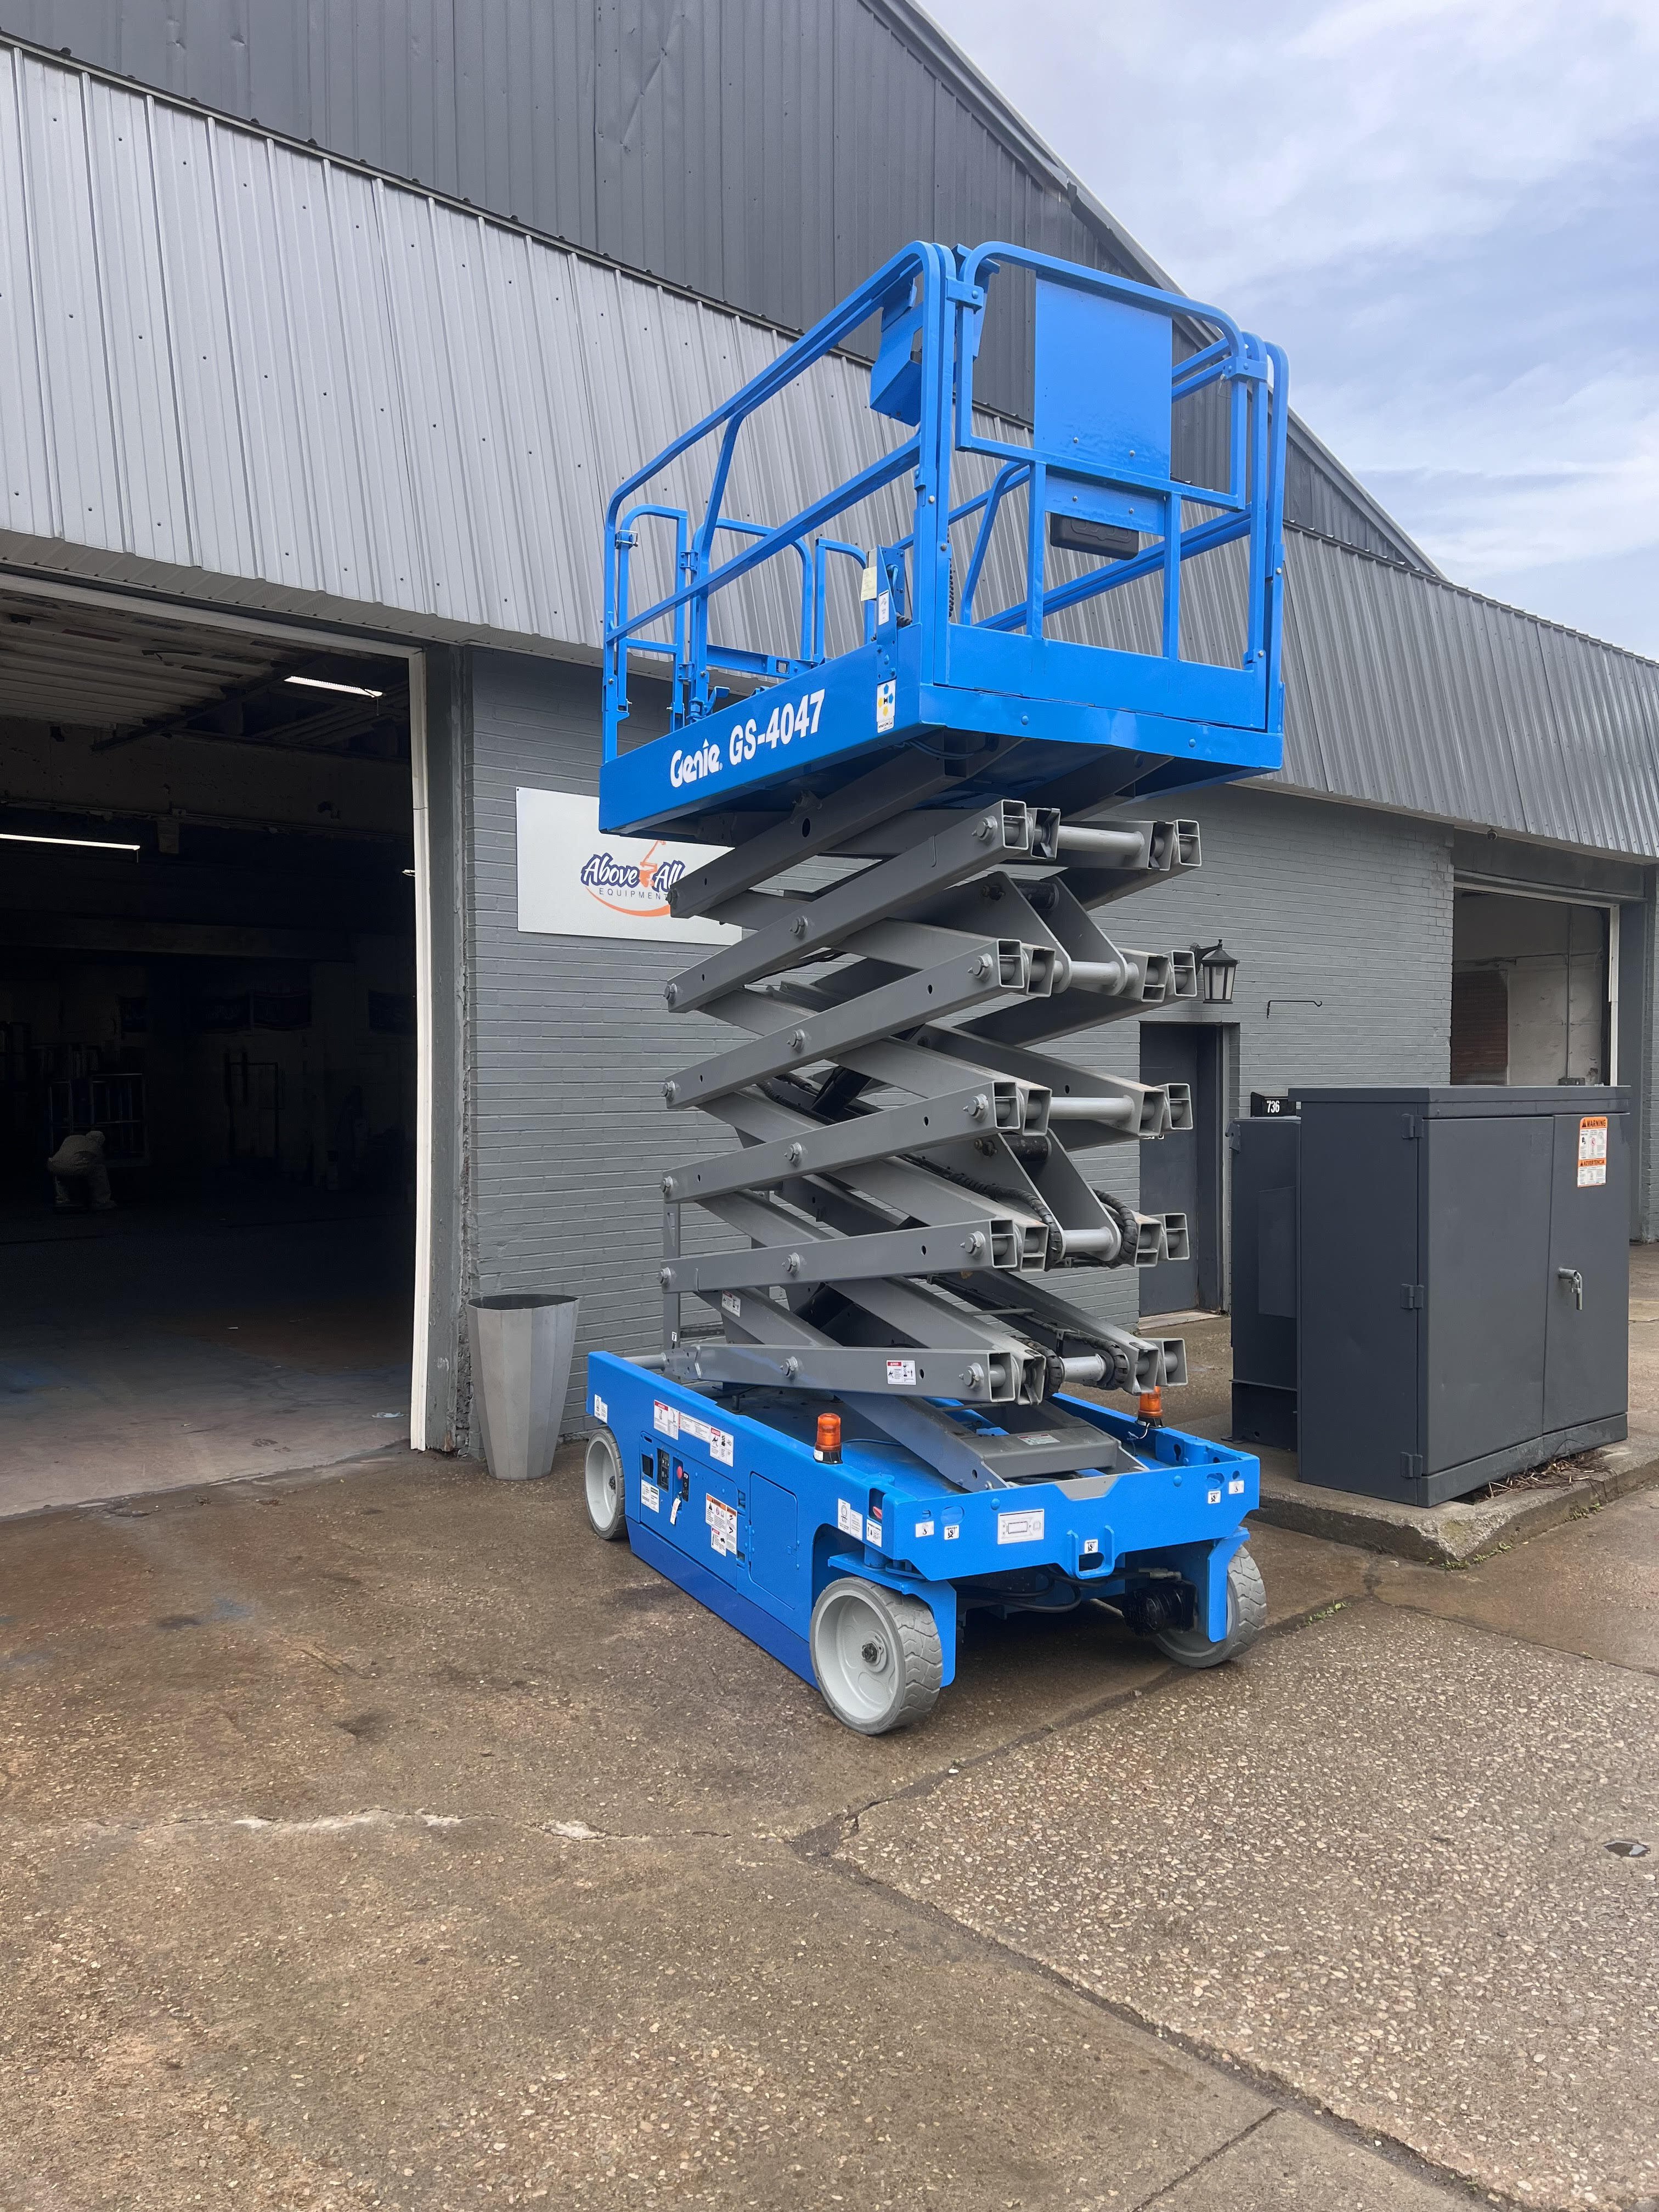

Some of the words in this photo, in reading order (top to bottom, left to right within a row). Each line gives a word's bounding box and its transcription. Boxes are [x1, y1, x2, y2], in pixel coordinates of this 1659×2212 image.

[729, 689, 825, 765] GS-4047
[581, 853, 640, 888] Above
[652, 860, 685, 893] All
[1266, 1100, 1280, 1113] 736
[1587, 1119, 1606, 1127] WARNING
